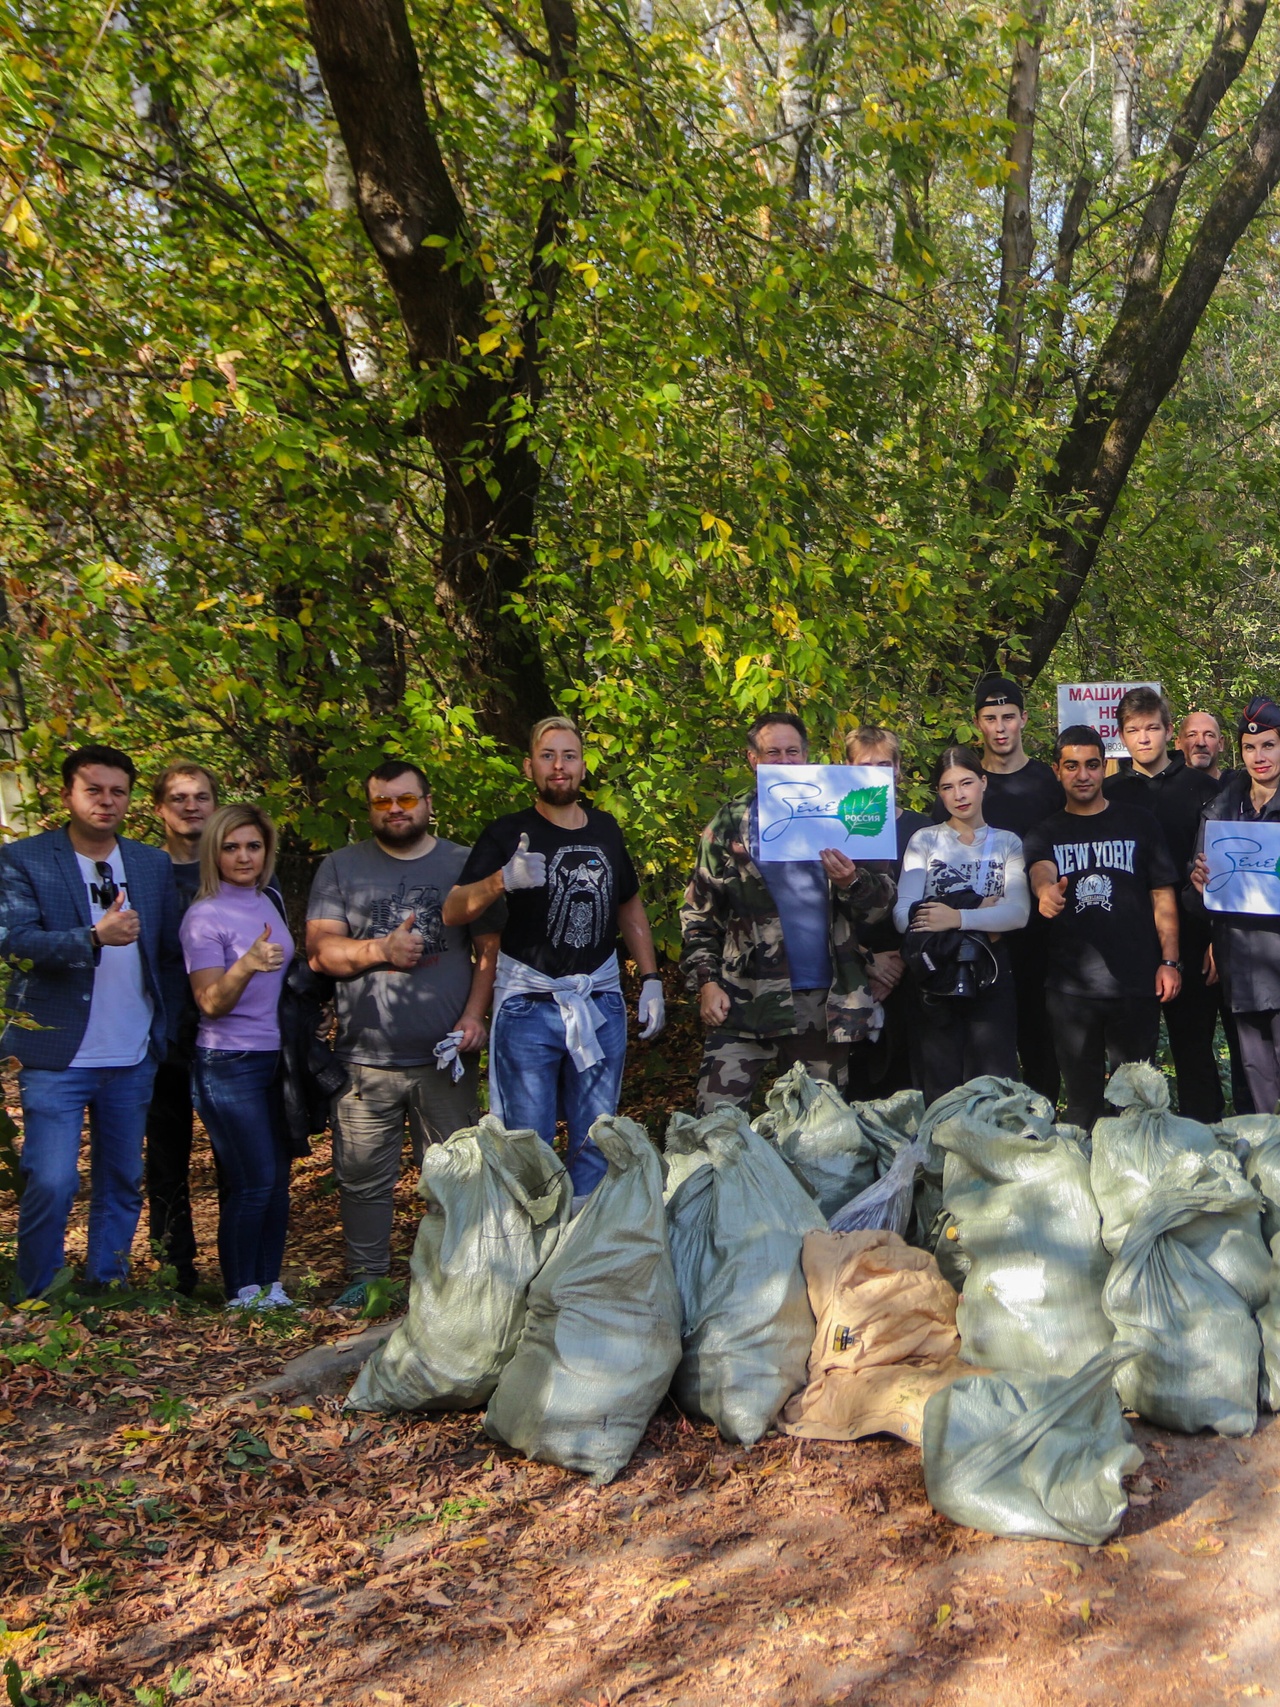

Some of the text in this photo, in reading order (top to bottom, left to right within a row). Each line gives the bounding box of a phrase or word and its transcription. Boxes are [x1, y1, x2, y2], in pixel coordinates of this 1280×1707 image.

[1069, 688, 1127, 701] МАШИ
[844, 814, 881, 822] РОССИЯ
[1053, 840, 1136, 876] NEW YORK
